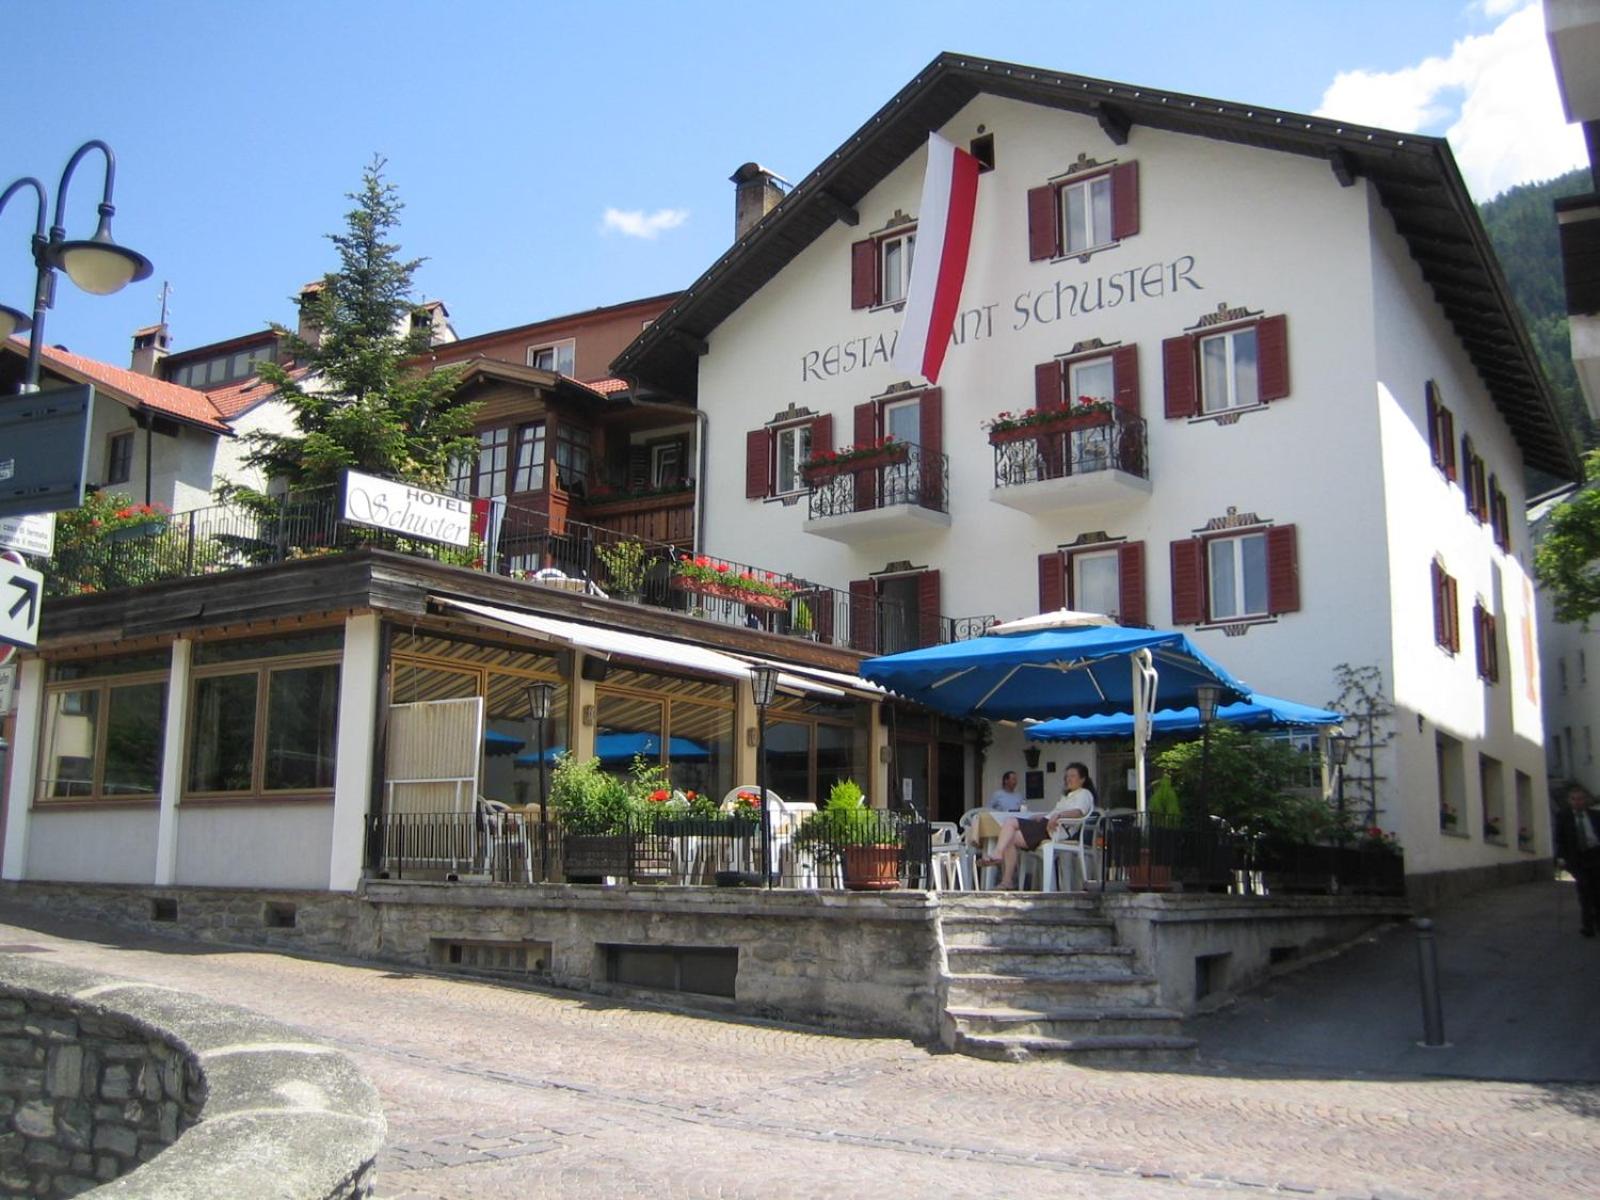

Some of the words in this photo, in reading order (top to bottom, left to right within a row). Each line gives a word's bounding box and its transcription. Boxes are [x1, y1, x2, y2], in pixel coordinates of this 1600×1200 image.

[801, 303, 999, 382] RESTANT
[348, 487, 468, 542] Schuster
[406, 488, 468, 515] HOTEL
